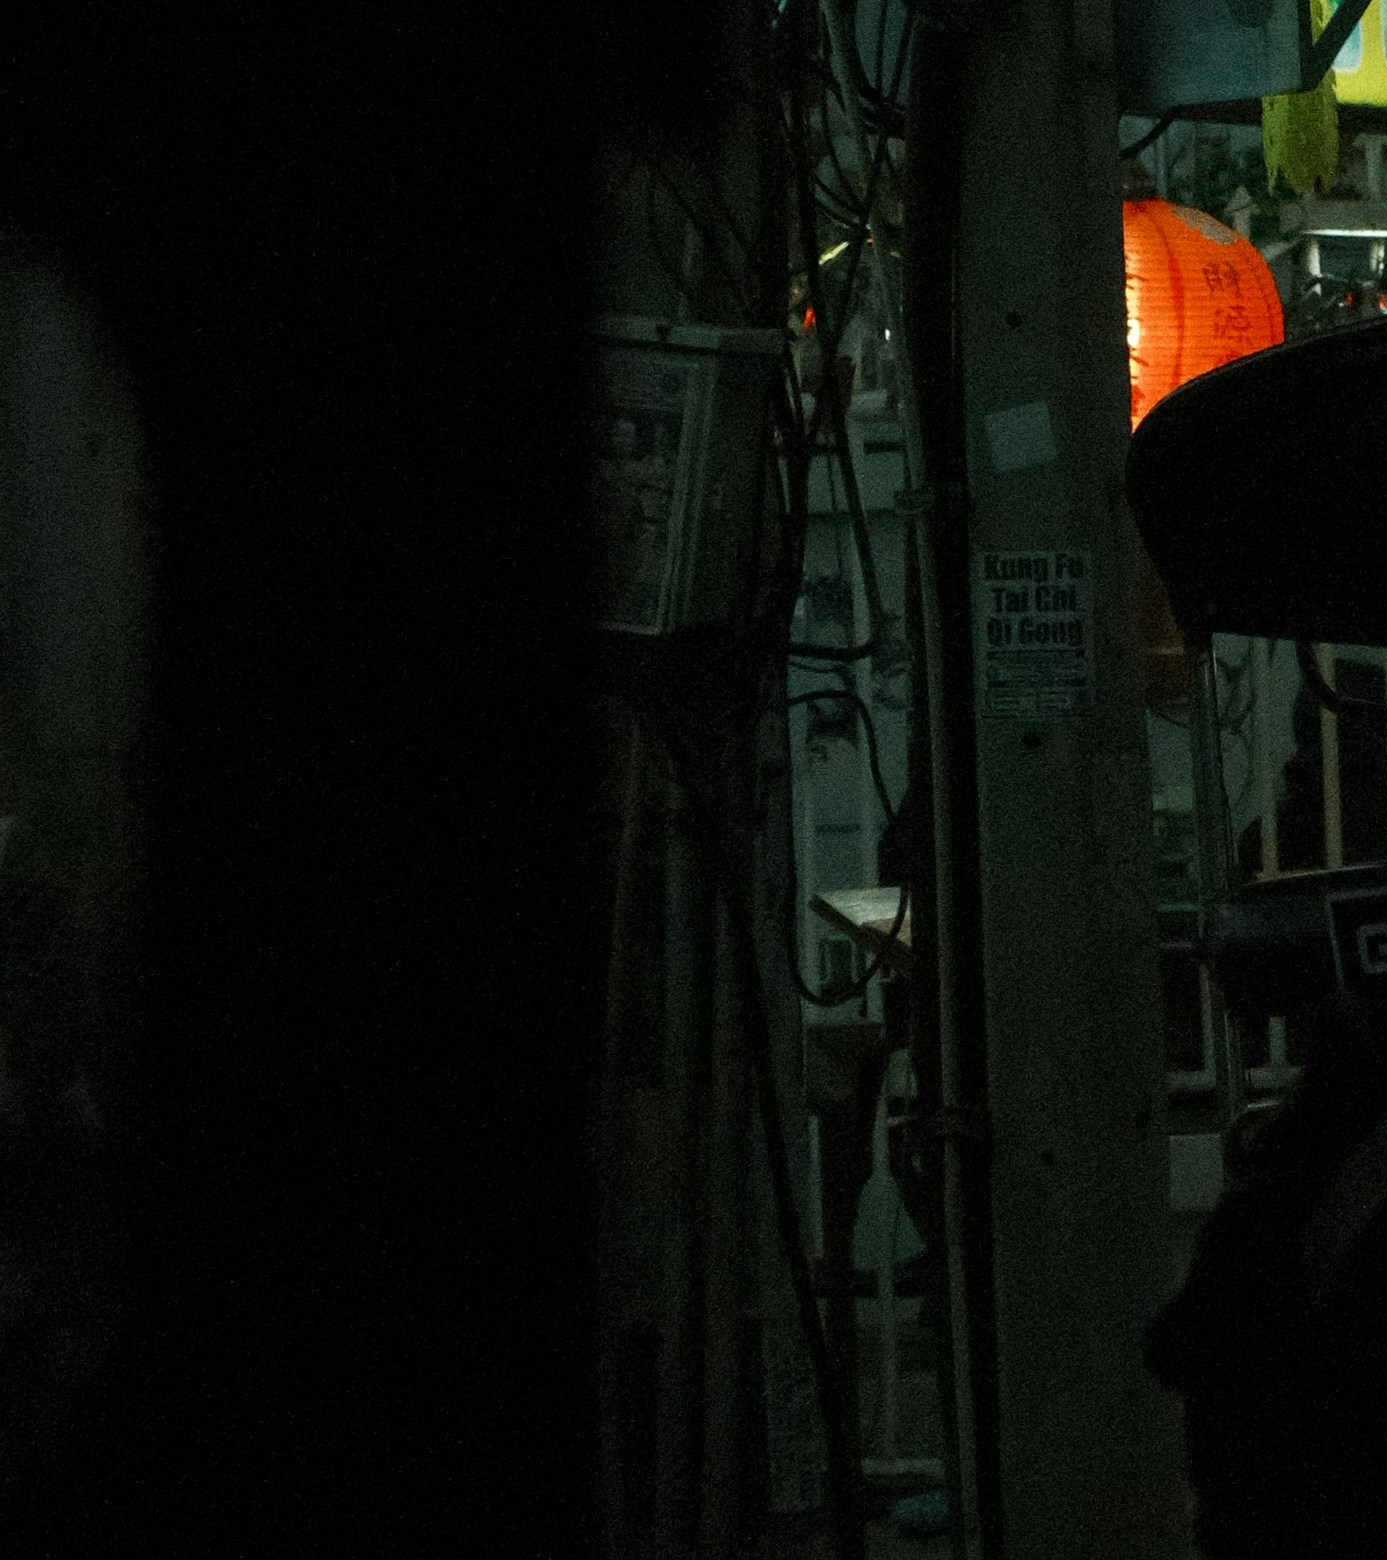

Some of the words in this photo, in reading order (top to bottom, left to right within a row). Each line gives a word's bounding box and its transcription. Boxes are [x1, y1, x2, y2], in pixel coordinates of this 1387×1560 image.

[985, 555, 1047, 582] Kung
[1056, 554, 1083, 578] Fu
[992, 586, 1027, 612] Tai
[1036, 586, 1076, 611] Chi
[989, 618, 1010, 646] Qi
[1020, 619, 1081, 645] Gong
